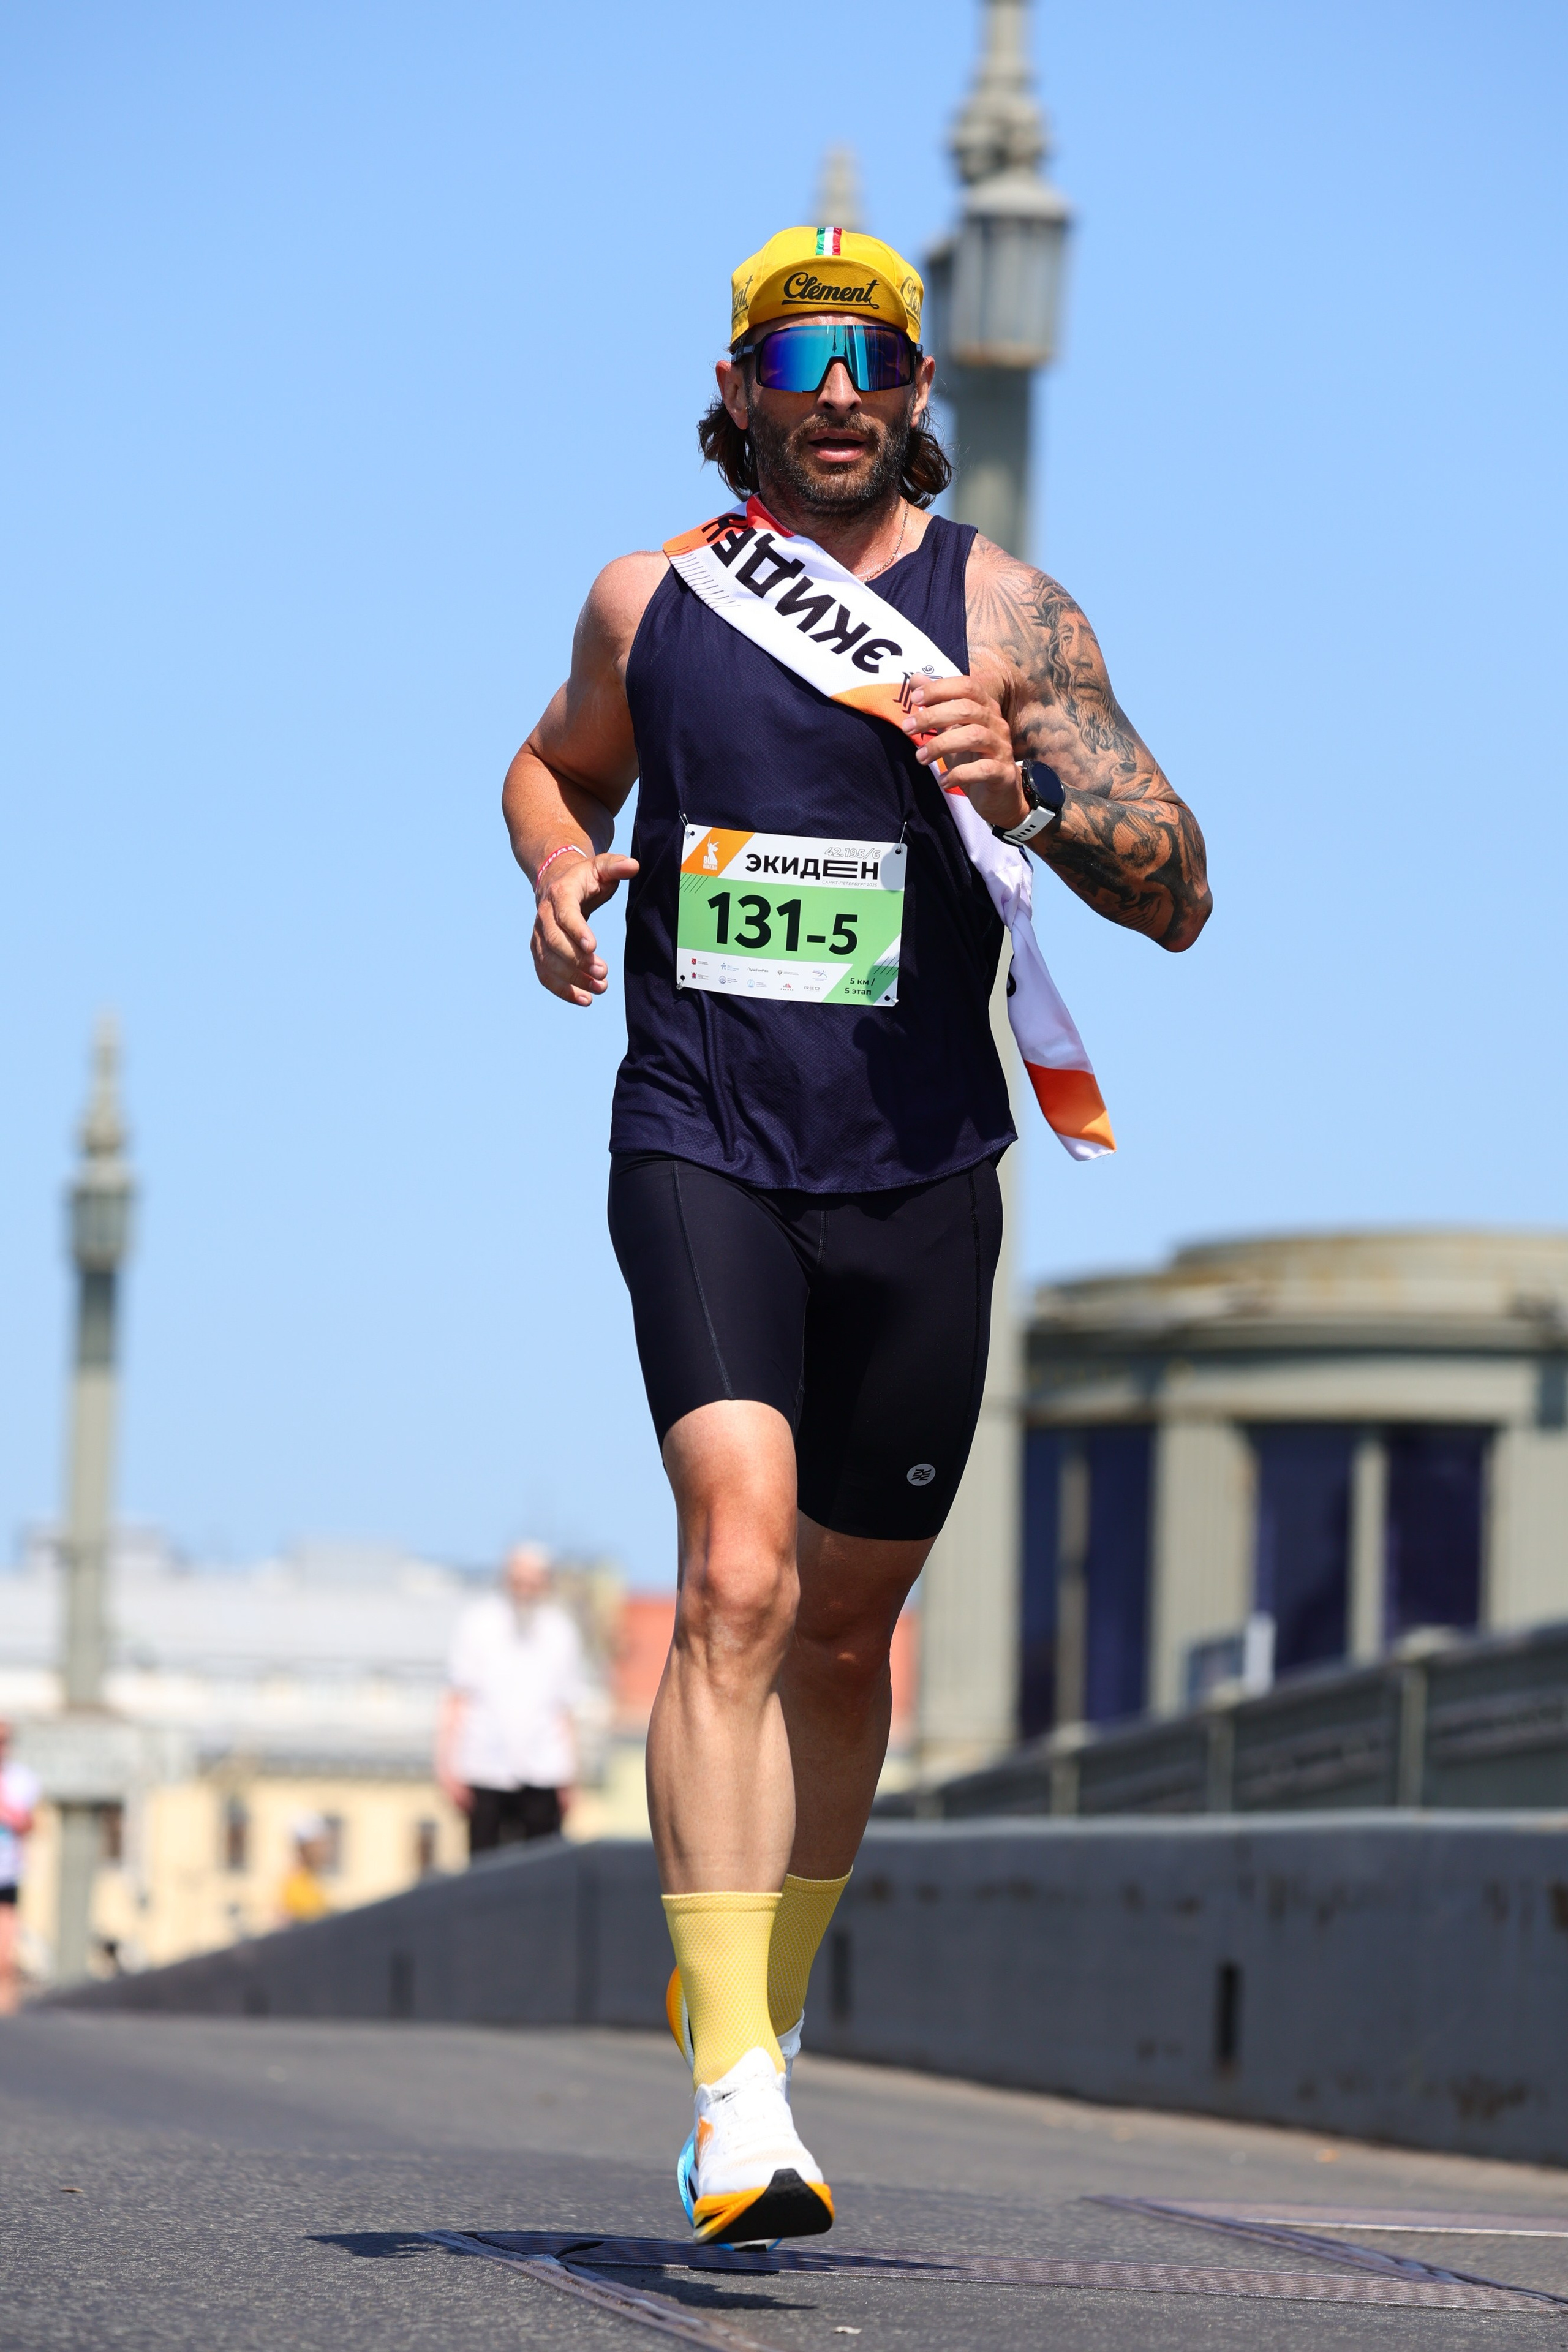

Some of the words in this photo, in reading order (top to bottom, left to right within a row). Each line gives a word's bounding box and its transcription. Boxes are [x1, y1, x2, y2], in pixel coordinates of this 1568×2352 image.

[782, 271, 880, 309] Clément
[745, 853, 879, 880] ЭКИДЕН
[824, 846, 880, 859] 42.195/6
[707, 892, 858, 956] 131-5
